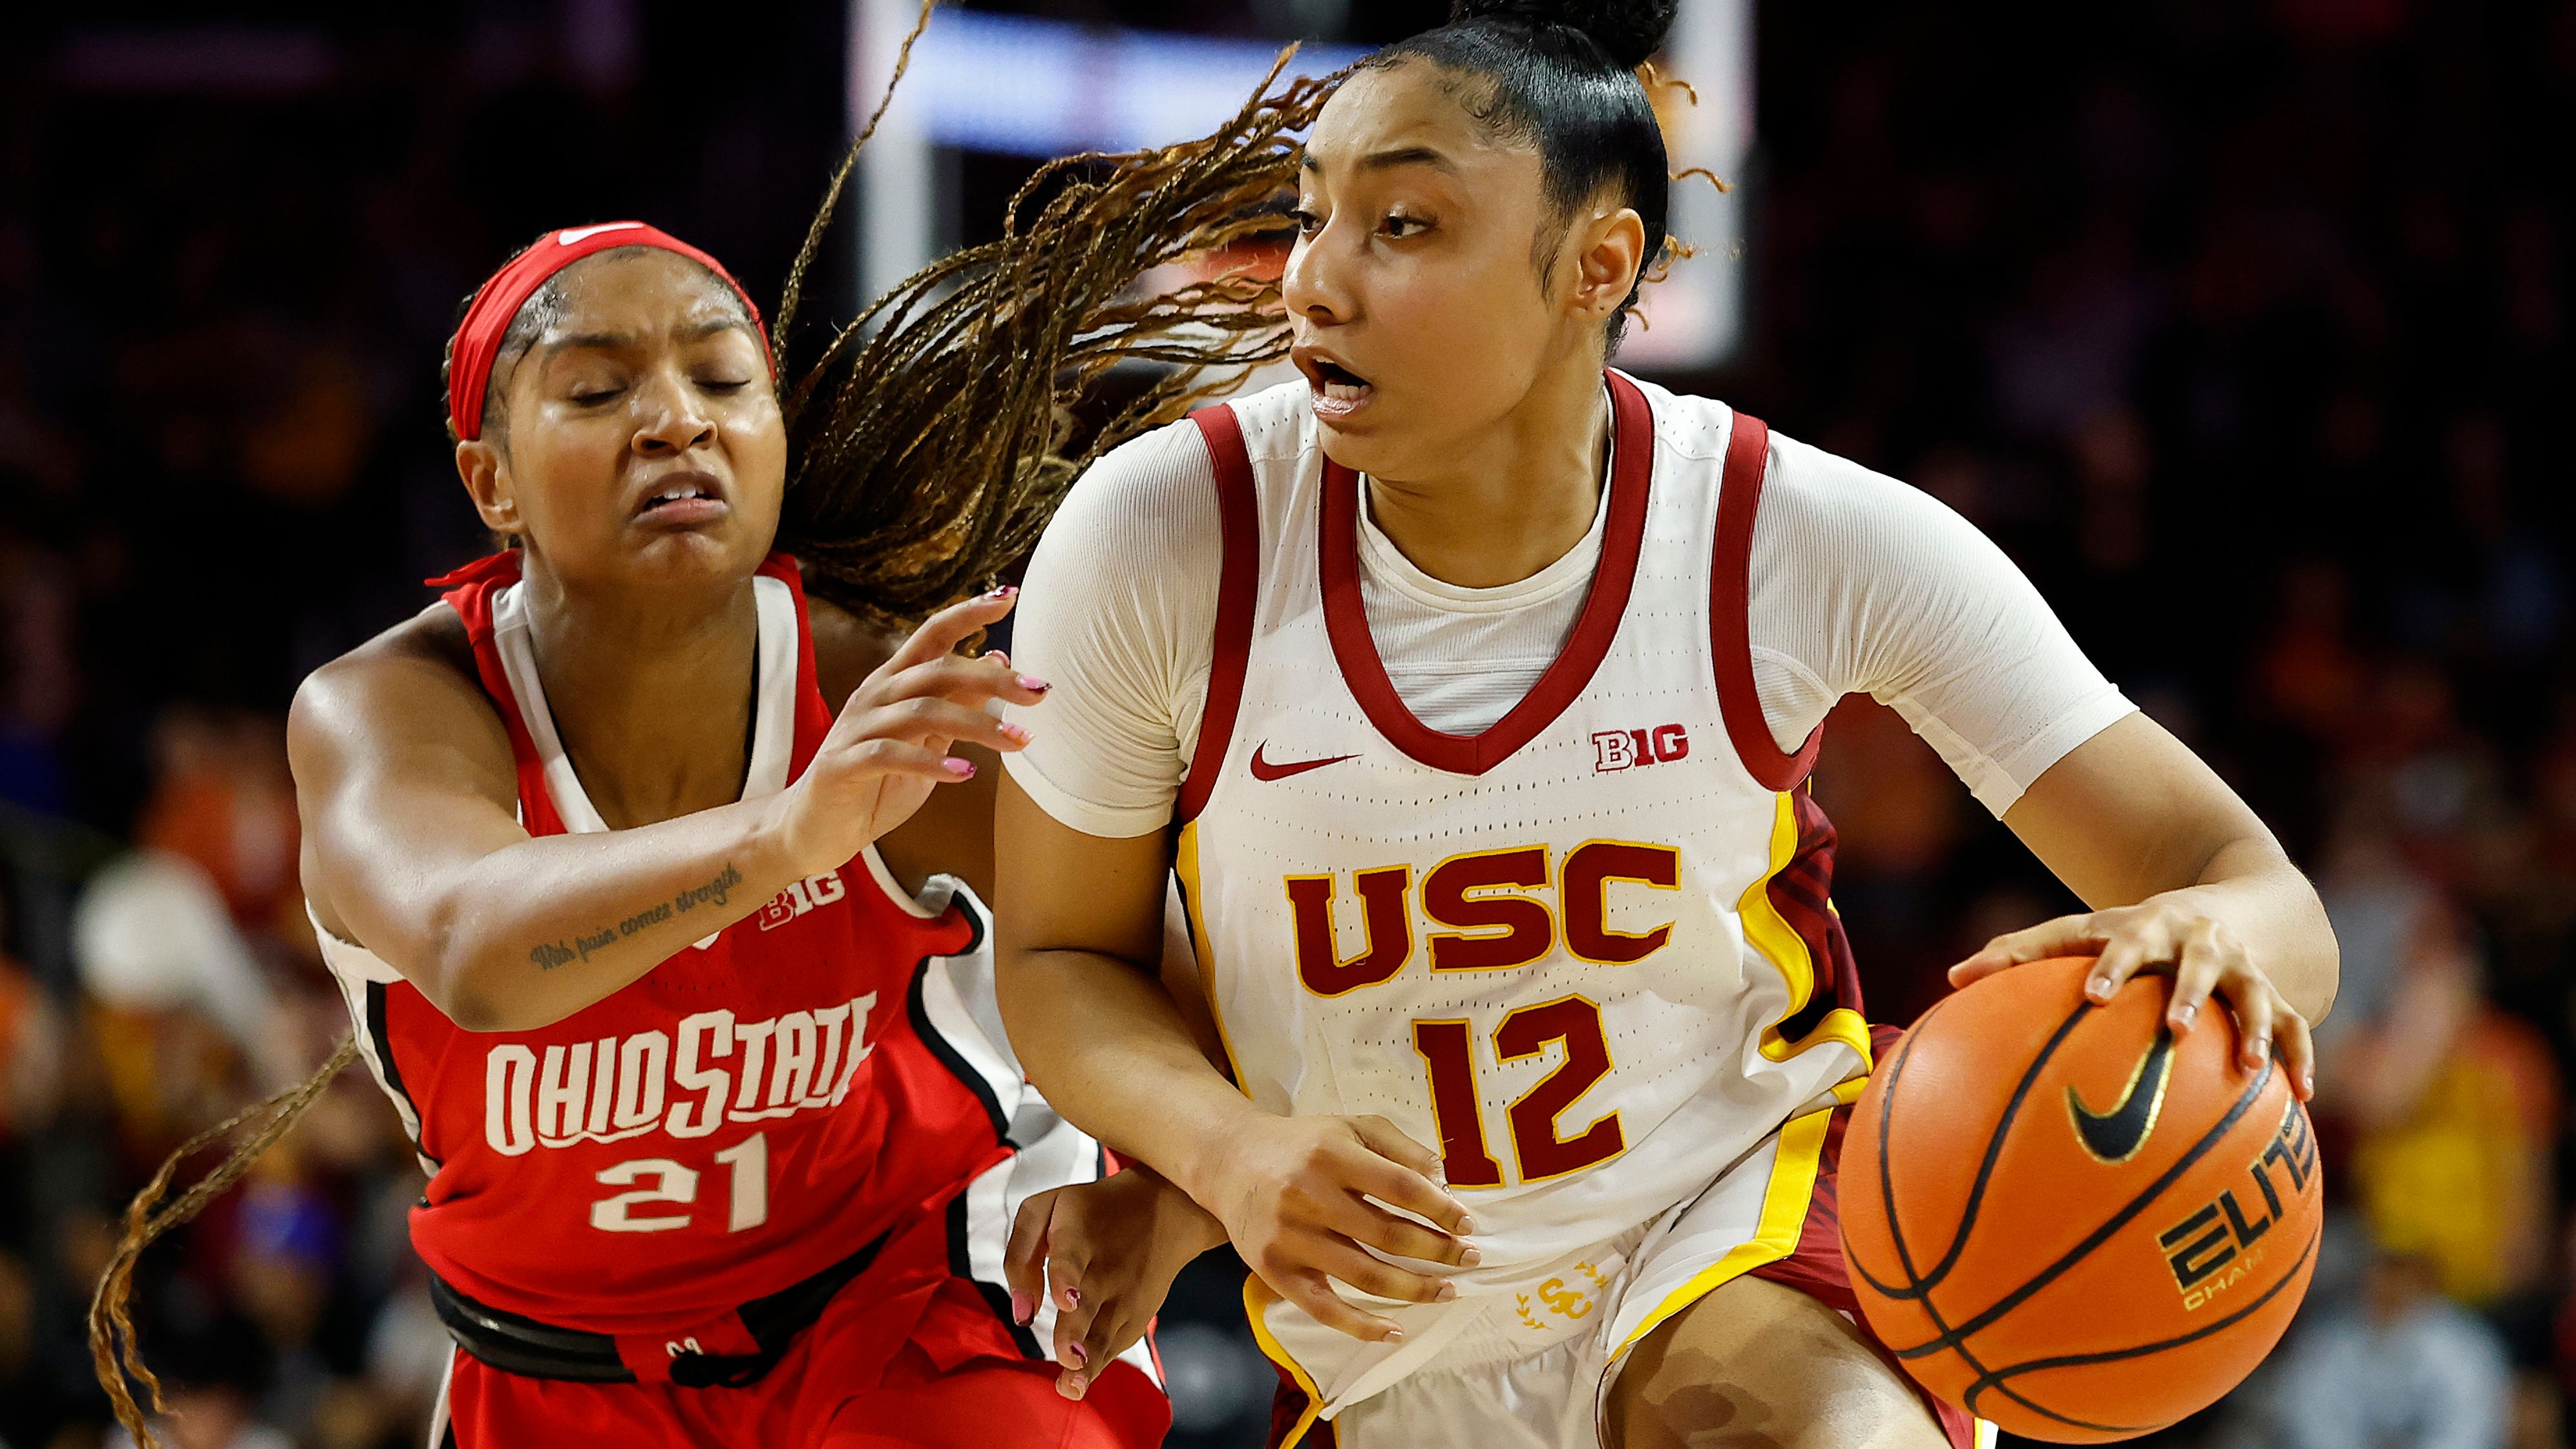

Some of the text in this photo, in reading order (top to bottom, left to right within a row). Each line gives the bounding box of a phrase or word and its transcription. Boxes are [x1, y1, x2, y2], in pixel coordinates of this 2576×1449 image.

[575, 927, 618, 963] pain
[620, 902, 672, 936] comes
[676, 862, 742, 913] strength
[1283, 839, 1680, 997] USC
[1411, 993, 1627, 1188] 12
[589, 1132, 768, 1233] 21
